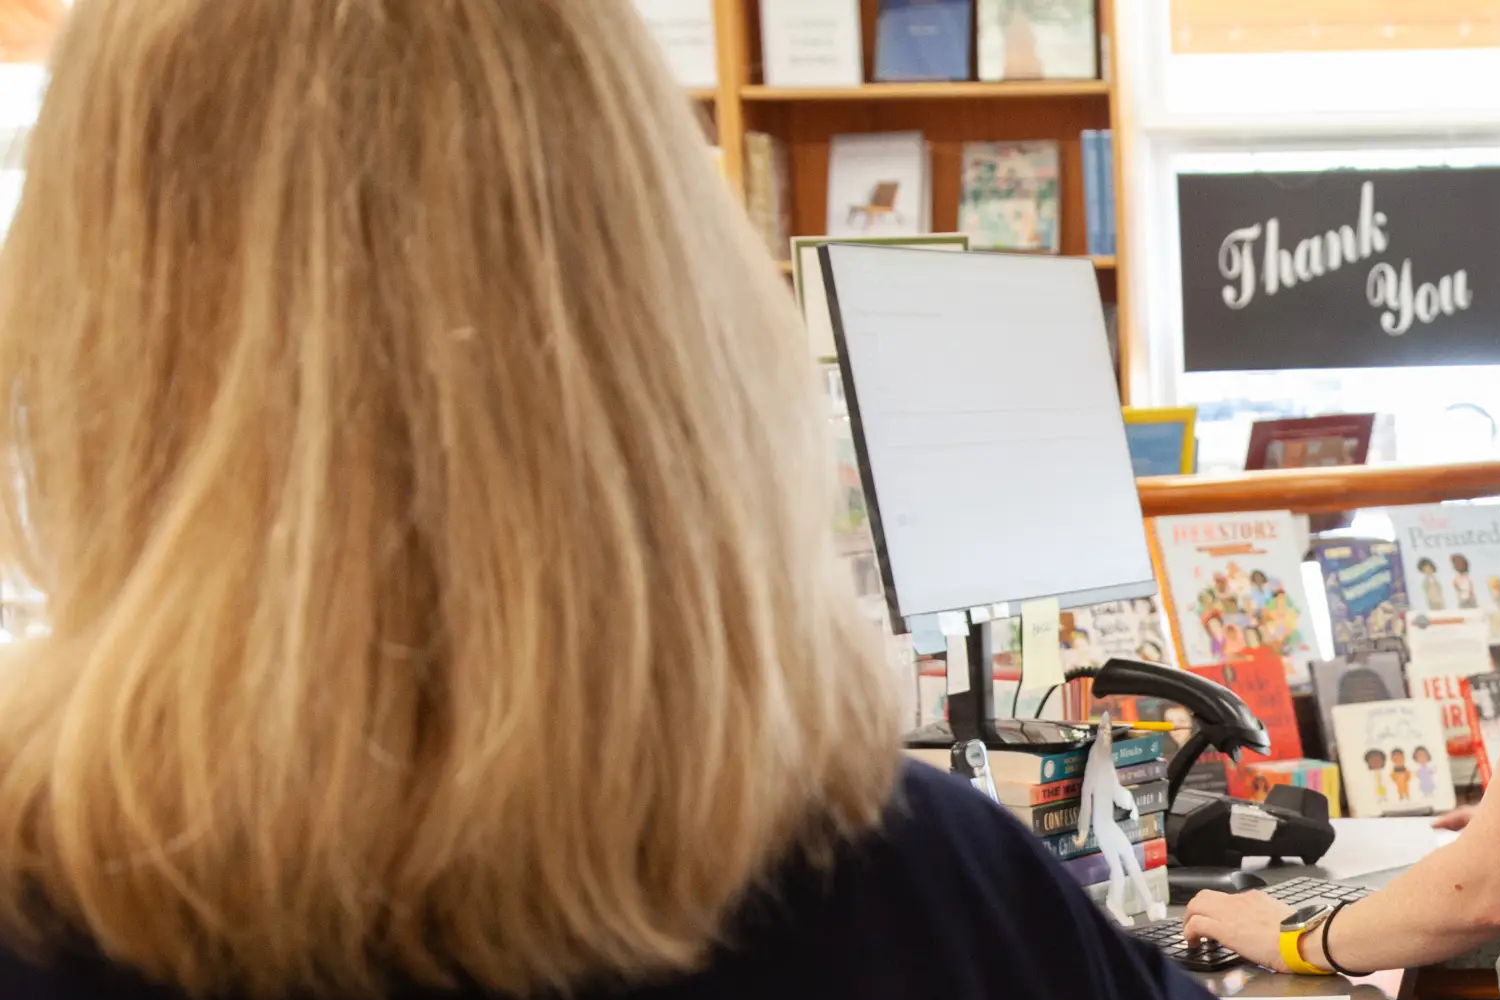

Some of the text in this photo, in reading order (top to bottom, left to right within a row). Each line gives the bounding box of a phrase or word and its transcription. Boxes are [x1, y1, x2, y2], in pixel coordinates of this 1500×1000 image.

[1217, 180, 1389, 310] Thank
[1366, 257, 1473, 336] You
[1042, 787, 1061, 799] THE
[1043, 806, 1081, 832] CONFESS
